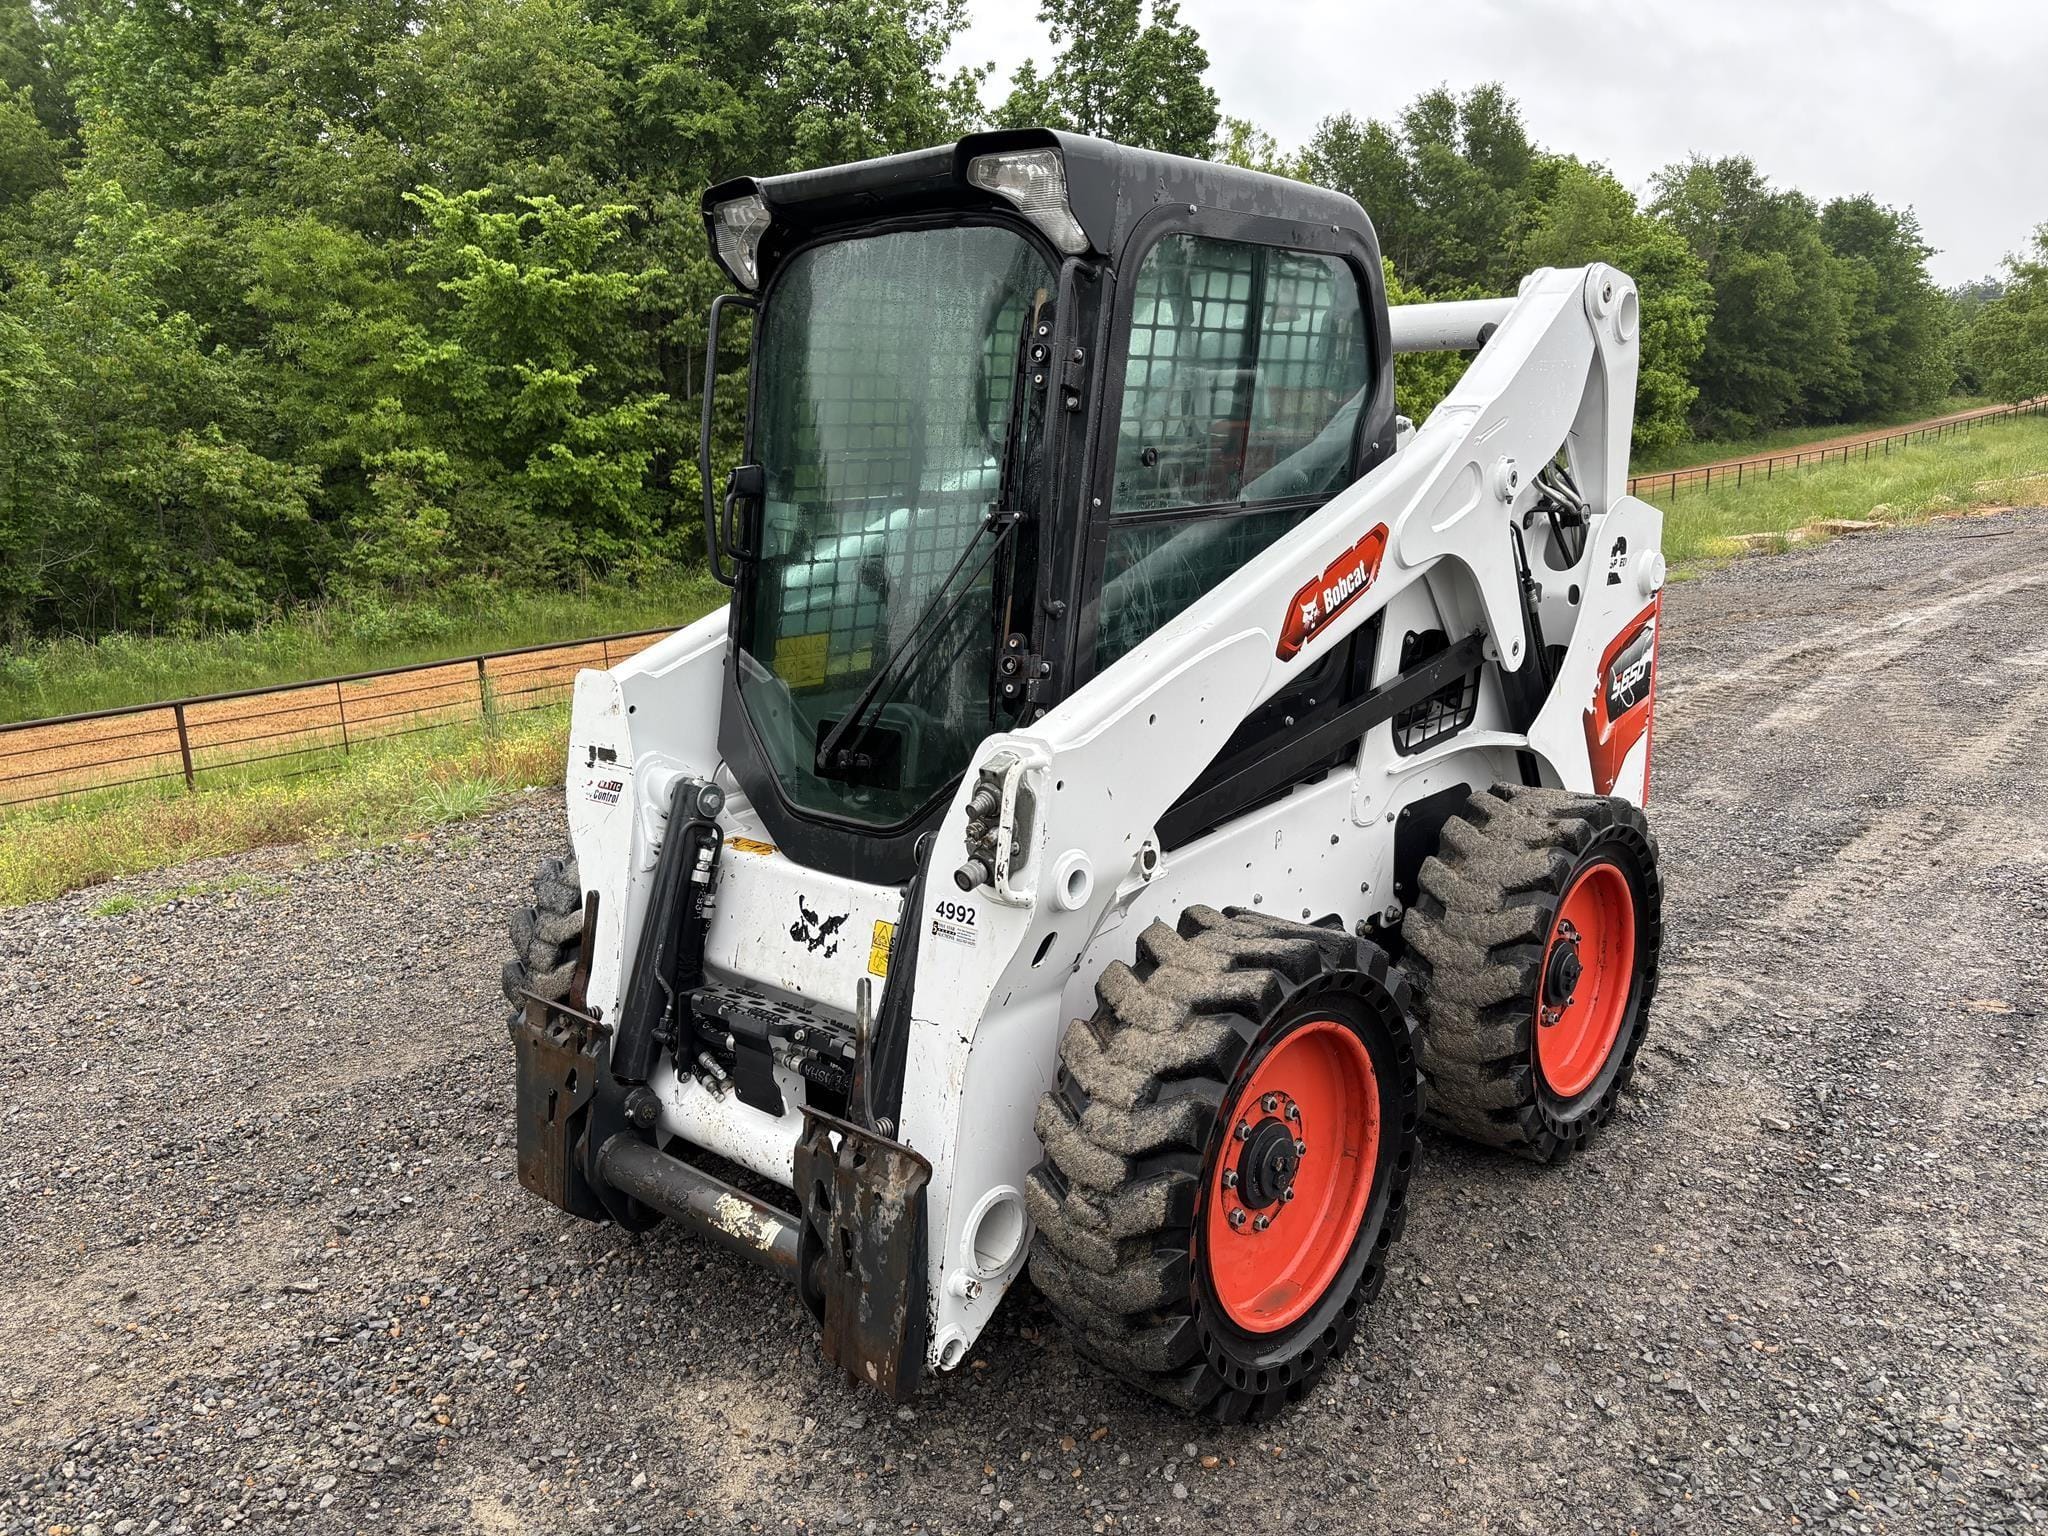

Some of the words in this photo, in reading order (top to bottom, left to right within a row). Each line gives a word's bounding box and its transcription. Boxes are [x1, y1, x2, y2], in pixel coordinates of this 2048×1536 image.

[1323, 559, 1367, 614] Bobcat
[593, 789, 620, 804] Control
[935, 900, 976, 926] 4992
